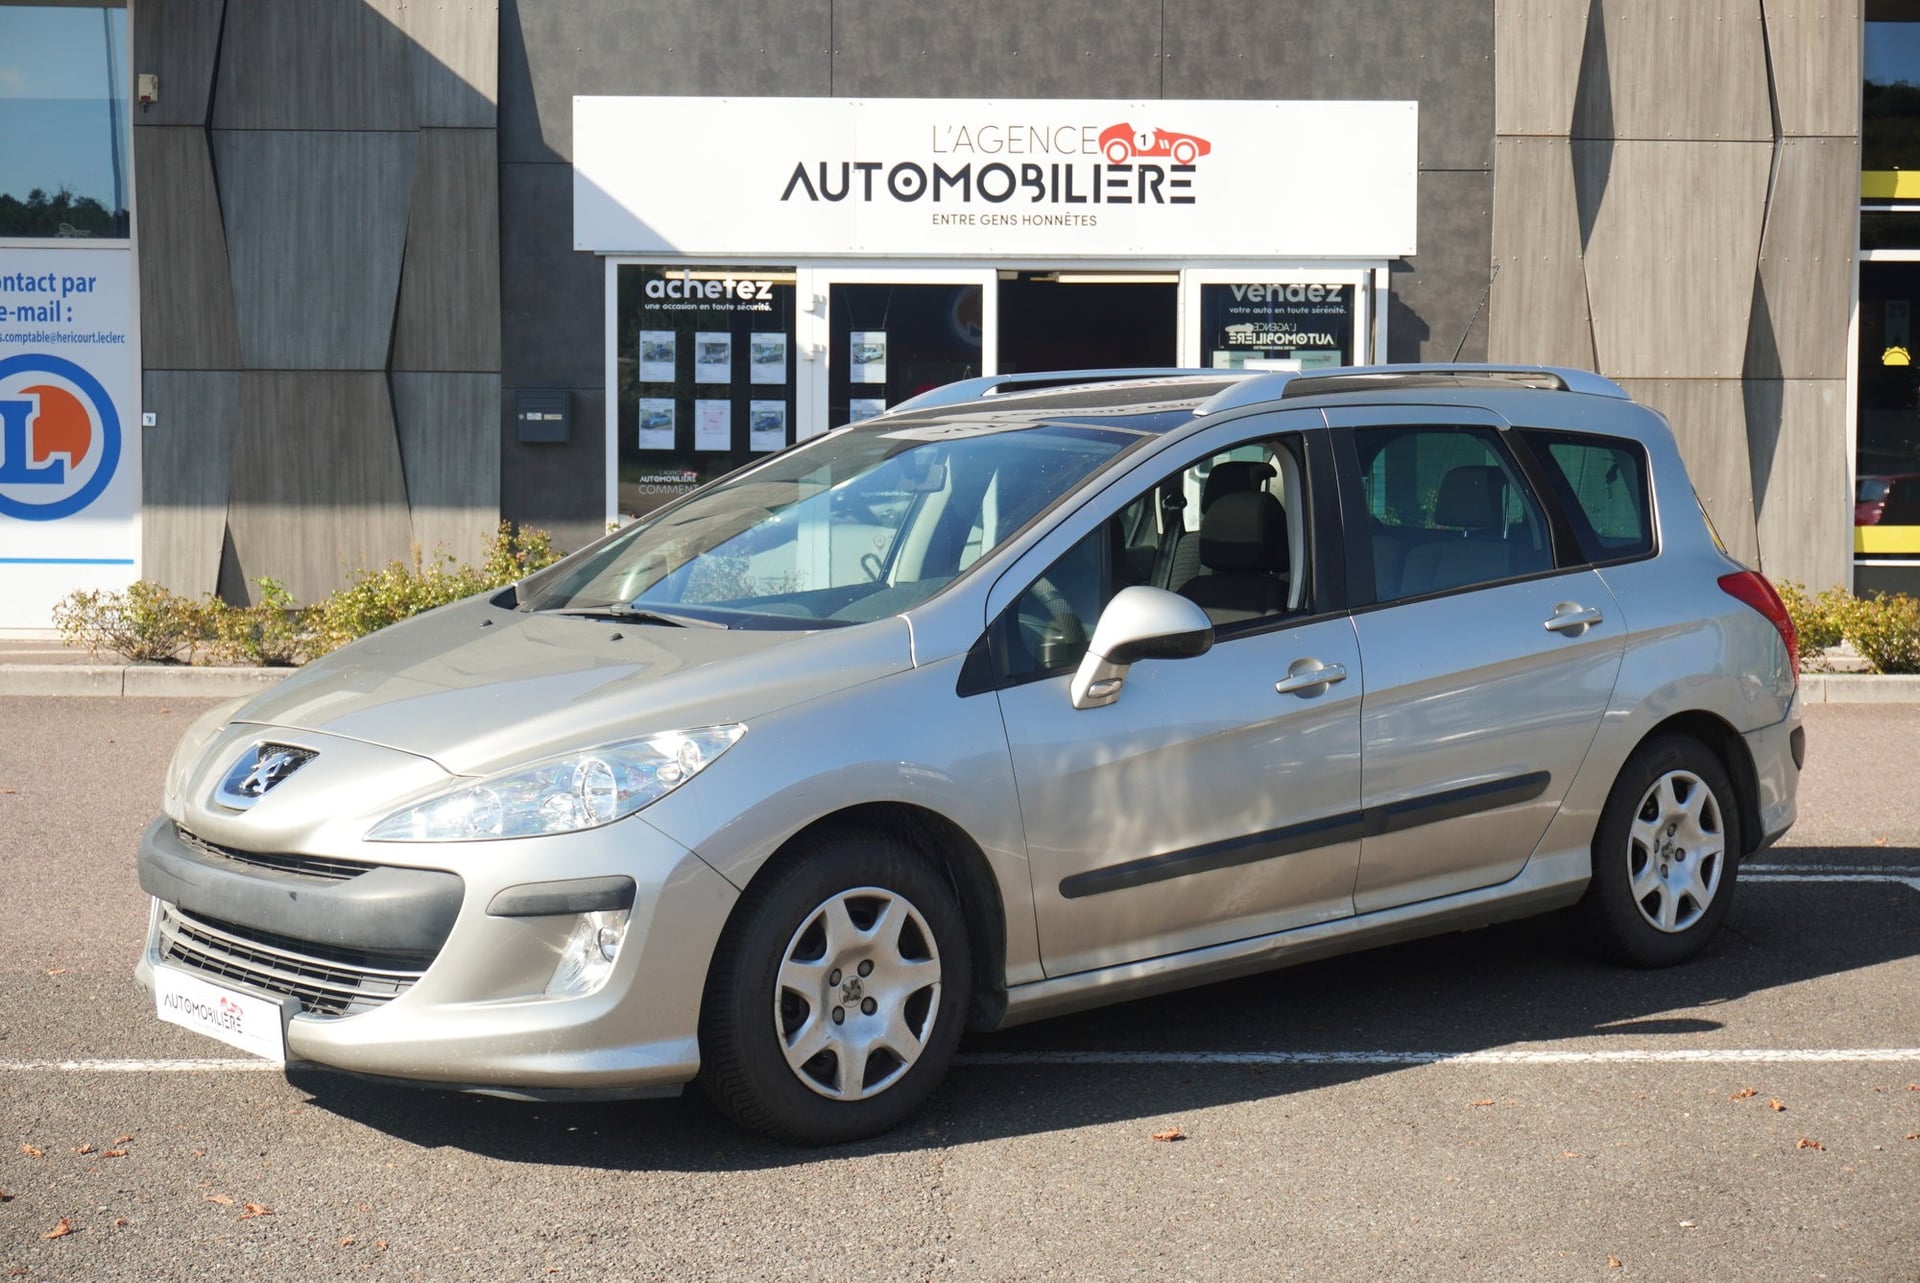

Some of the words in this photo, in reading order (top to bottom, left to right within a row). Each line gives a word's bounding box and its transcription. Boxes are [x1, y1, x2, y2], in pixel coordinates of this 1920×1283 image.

[933, 124, 1098, 154] L'AGENCE
[1141, 134, 1148, 146] 1
[932, 214, 976, 226] ENTRE
[980, 214, 1018, 226] GENS
[1021, 211, 1097, 227] HONNÊTES
[0, 273, 56, 292] ntact
[62, 276, 96, 298] par
[645, 269, 773, 299] achetez
[662, 302, 697, 310] occasion
[712, 302, 734, 310] toute
[737, 302, 773, 311] sécurité.
[1229, 306, 1251, 314] votre
[1253, 306, 1272, 314] auto
[1287, 306, 1309, 314] toute
[1311, 305, 1347, 314] sérénité.
